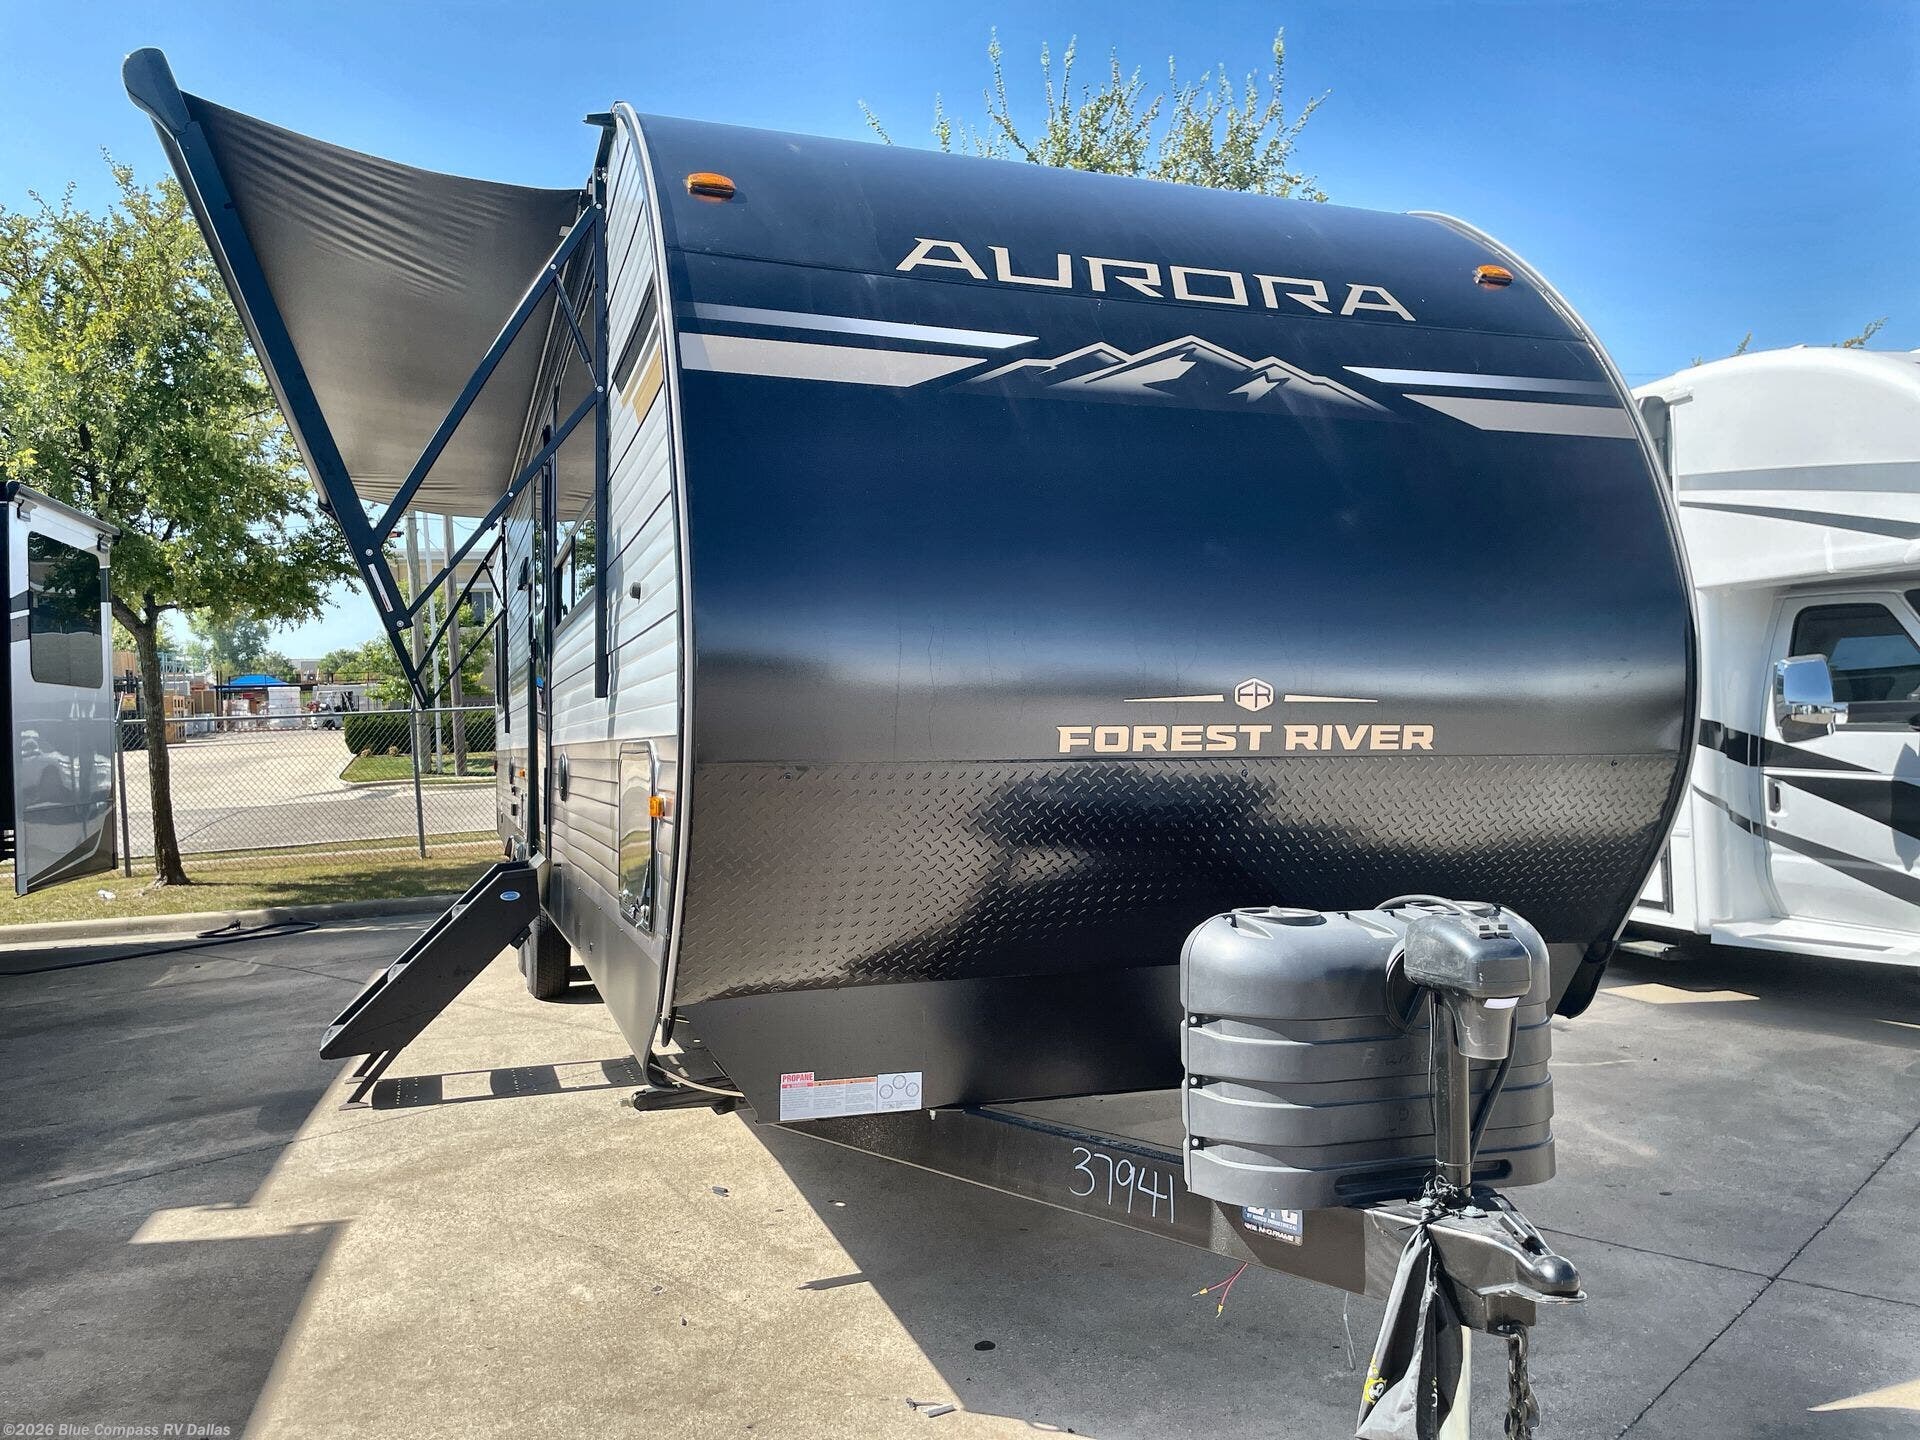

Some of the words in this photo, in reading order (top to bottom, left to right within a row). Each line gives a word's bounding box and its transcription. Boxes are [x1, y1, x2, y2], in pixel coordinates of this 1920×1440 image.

[896, 237, 1416, 321] AURORA
[1056, 725, 1272, 752] FOREST
[1284, 724, 1434, 750] RIVER
[782, 1073, 813, 1083] PROPANE
[1067, 1147, 1174, 1223] 37941
